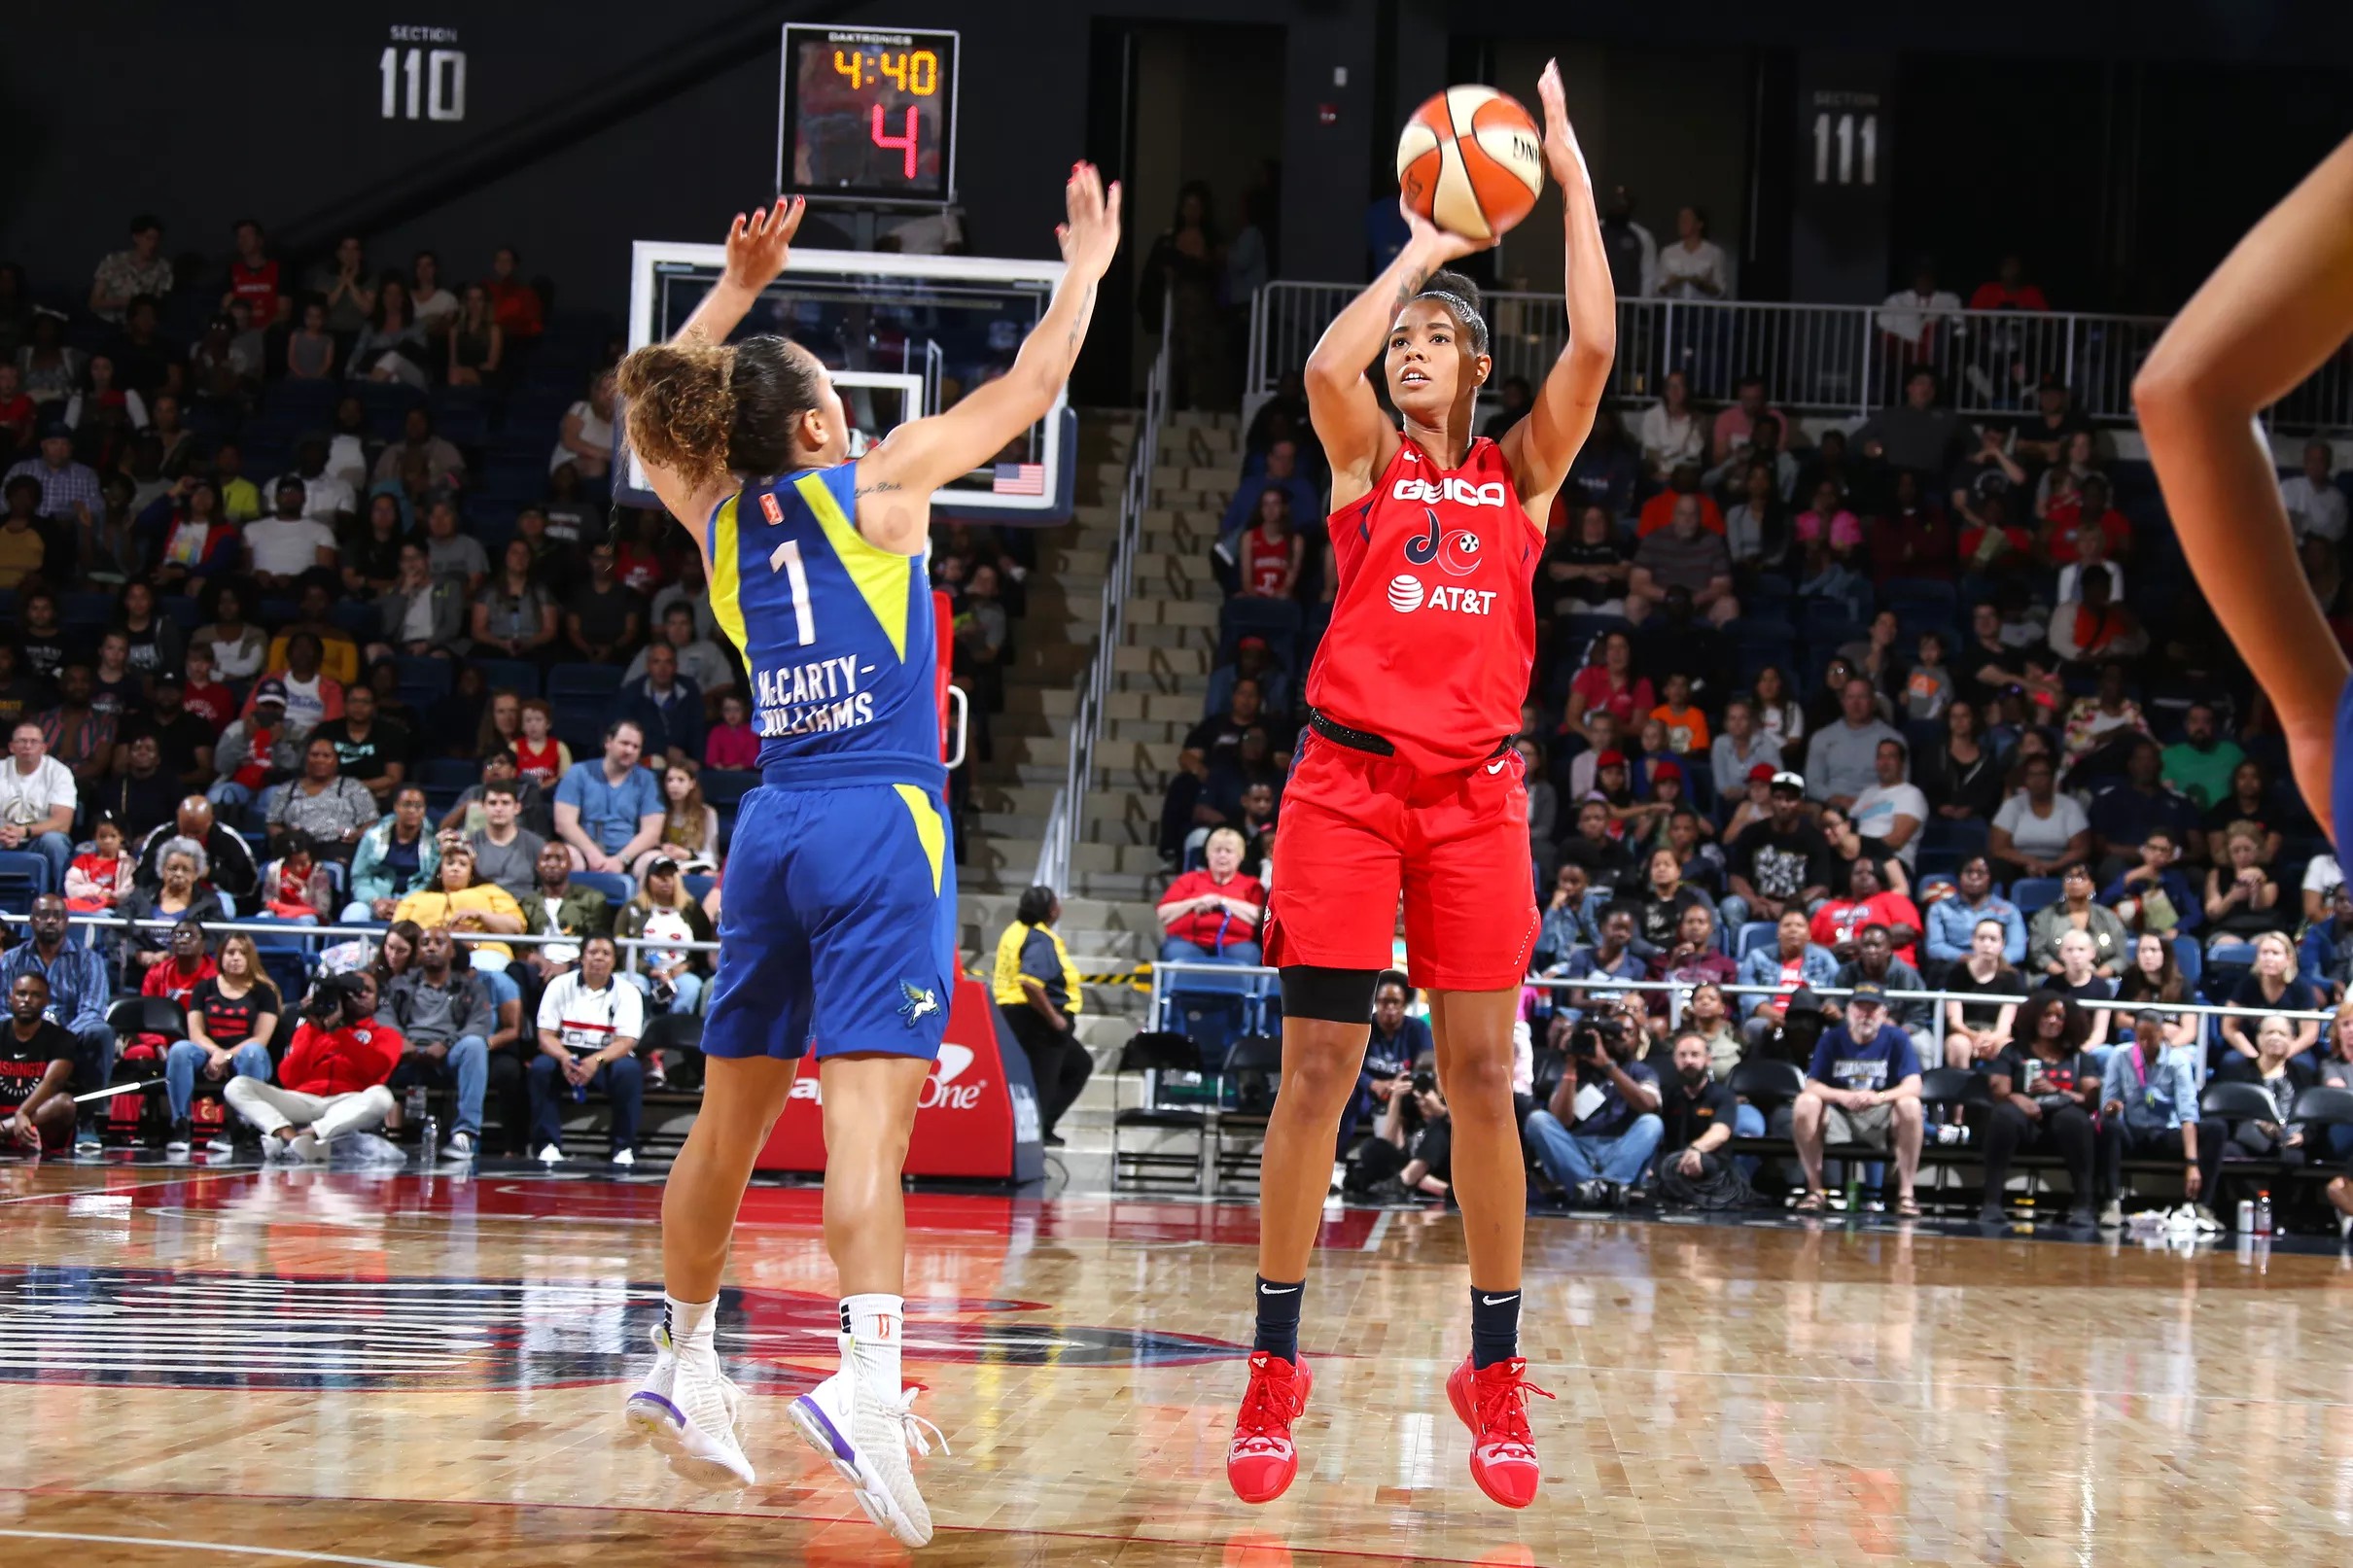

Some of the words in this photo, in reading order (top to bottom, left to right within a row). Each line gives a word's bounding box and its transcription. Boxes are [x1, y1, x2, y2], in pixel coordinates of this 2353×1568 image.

[390, 24, 458, 42] SECTION
[828, 32, 913, 46] DAKTRONICS
[379, 46, 467, 121] 110
[833, 51, 937, 95] 4:40
[1813, 90, 1879, 107] SECTION
[871, 104, 919, 179] 4
[1812, 113, 1877, 184] 111
[1392, 477, 1505, 507] GEICO
[769, 539, 816, 646] 1
[1427, 585, 1497, 615] AT&T
[760, 691, 874, 738] WILLIAMS
